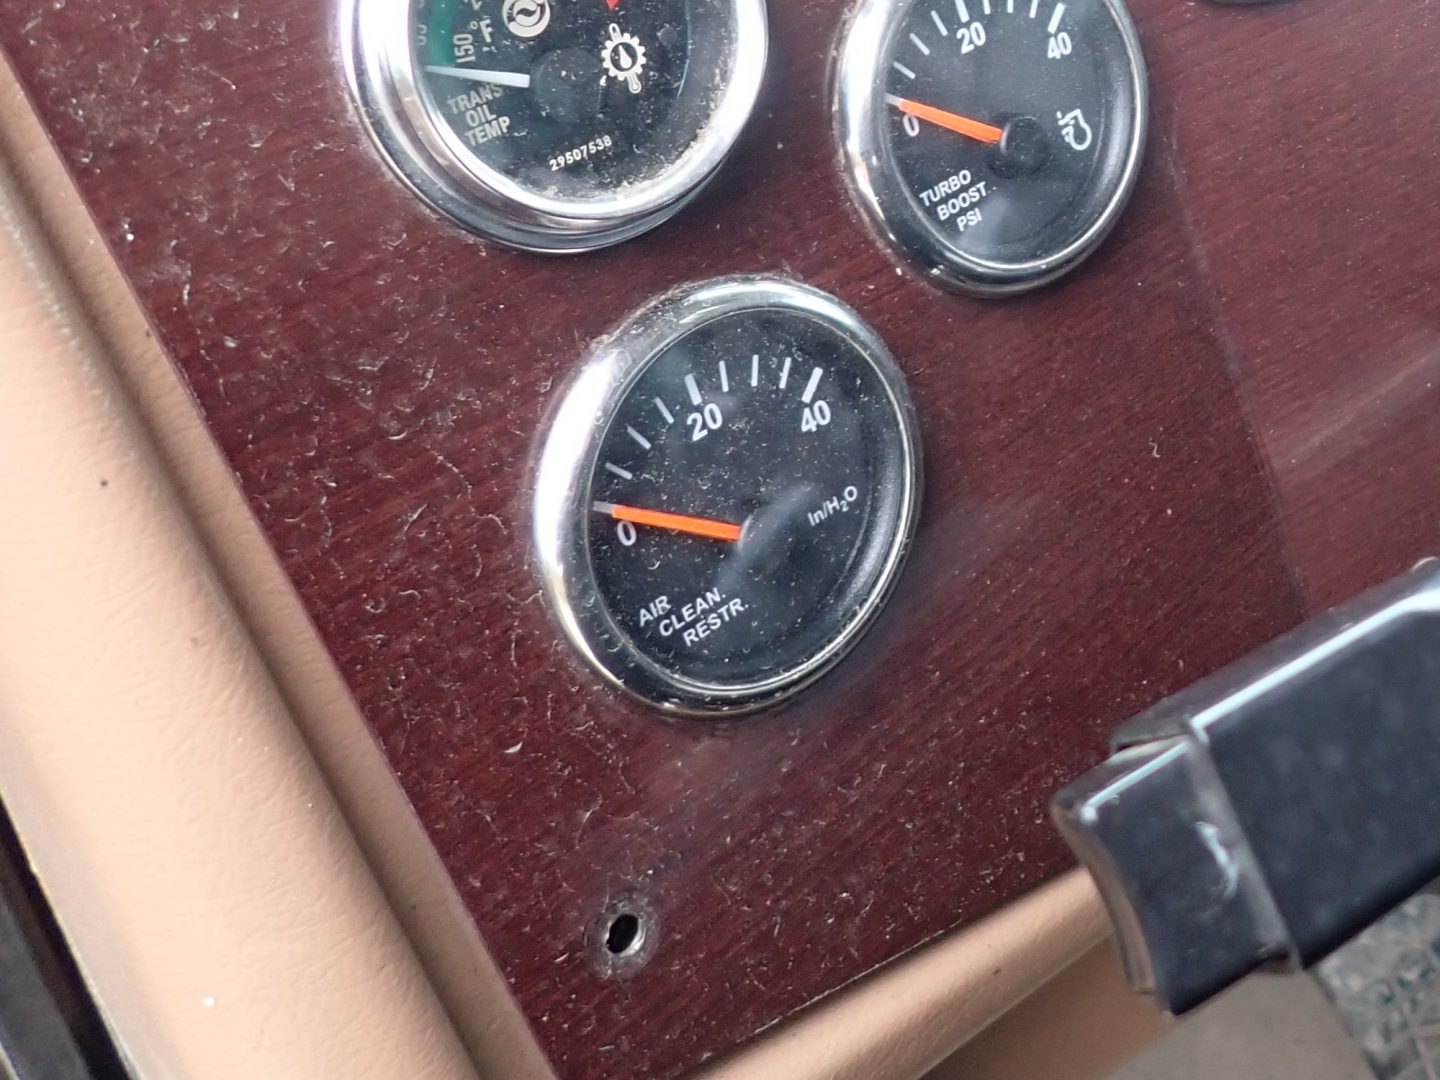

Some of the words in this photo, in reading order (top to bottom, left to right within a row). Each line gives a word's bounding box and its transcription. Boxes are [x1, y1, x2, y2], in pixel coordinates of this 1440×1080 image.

[453, 33, 476, 64] 150
[956, 21, 986, 54] 20
[1047, 32, 1072, 60] 40
[464, 117, 510, 147] TEMP
[465, 105, 497, 128] OIL
[903, 114, 920, 137] 0
[549, 135, 613, 171] 29507538
[919, 170, 972, 206] TURBO
[937, 182, 987, 221] BOOST
[956, 208, 982, 231] PSI
[686, 403, 722, 441] 20
[800, 400, 831, 433] 40
[617, 521, 637, 547] 0
[638, 595, 672, 626] AIR
[659, 587, 727, 637] CLEAN.
[683, 598, 750, 647] RESTR.
